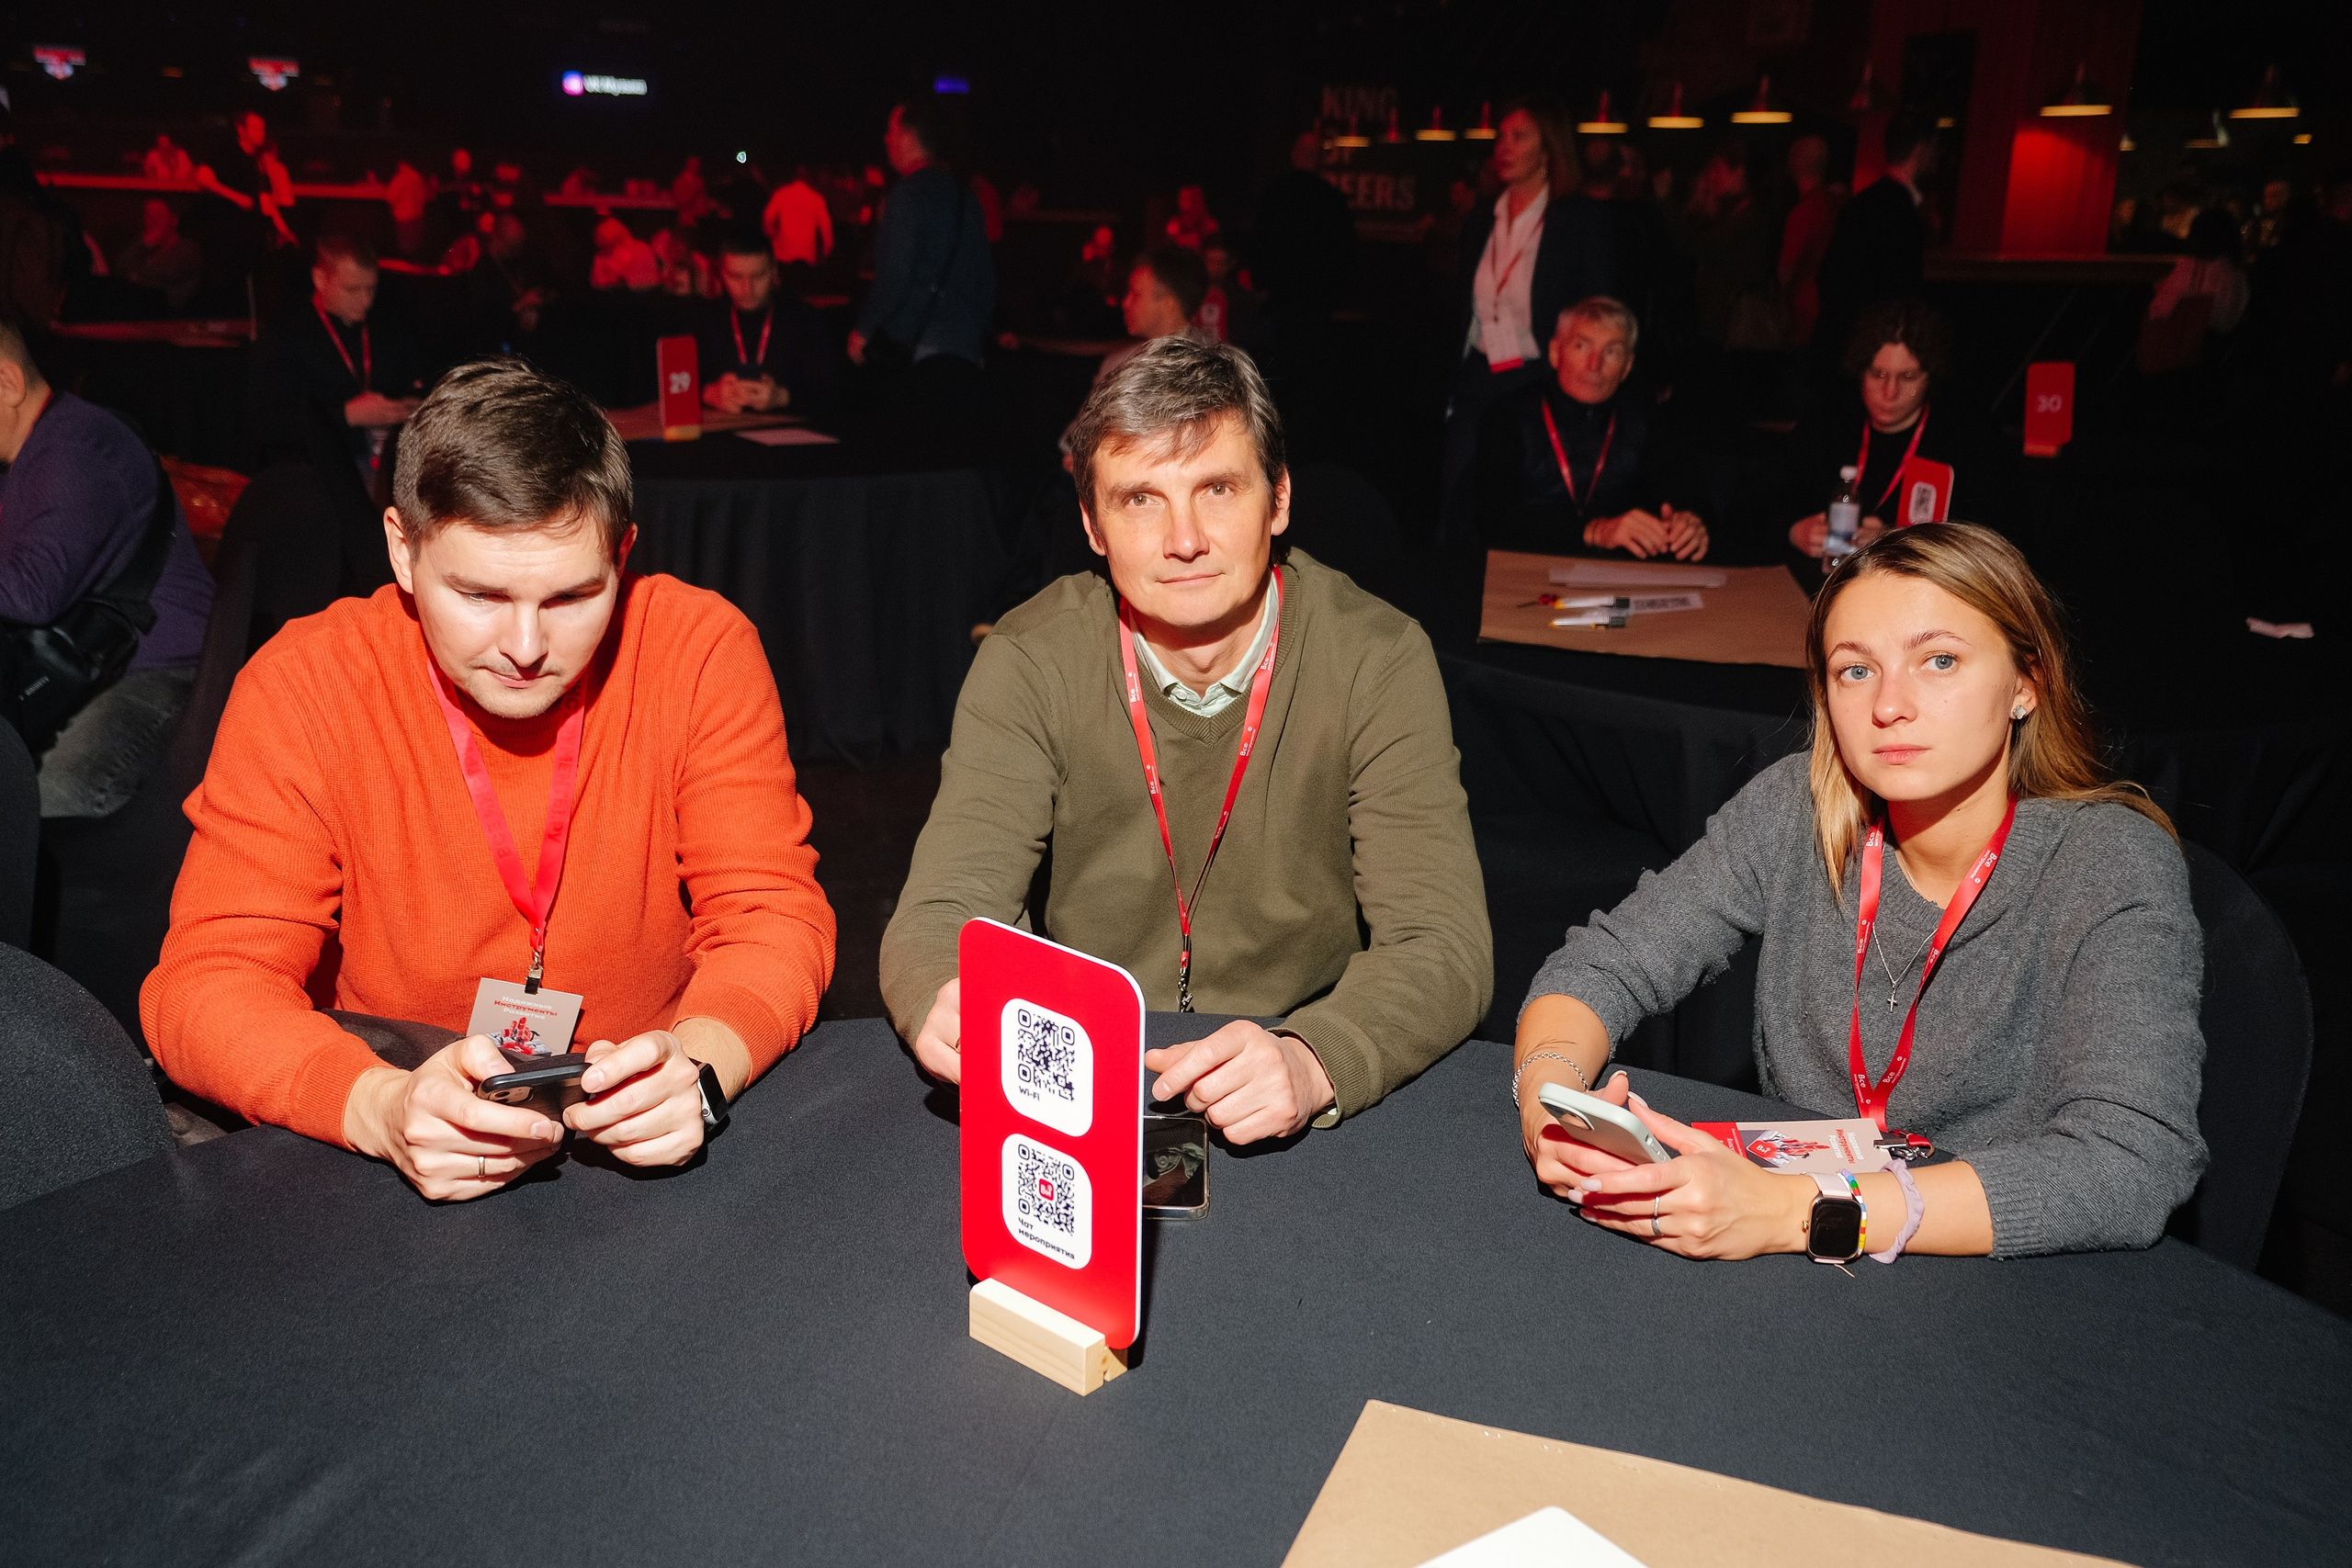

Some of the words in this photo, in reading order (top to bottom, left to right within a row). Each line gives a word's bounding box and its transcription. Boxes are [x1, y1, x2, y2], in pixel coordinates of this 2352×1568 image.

[1322, 85, 1397, 120] KING
[669, 371, 691, 394] 29
[2037, 394, 2063, 412] 30
[1239, 742, 1249, 757] Все
[1865, 831, 1875, 847] Все
[1984, 852, 1997, 868] Все
[1858, 1074, 1866, 1089] Все
[1883, 1071, 1895, 1084] Все
[1019, 1085, 1040, 1100] Wi-Fi
[1018, 1217, 1034, 1230] Чат
[1018, 1228, 1075, 1259] мероприятия
